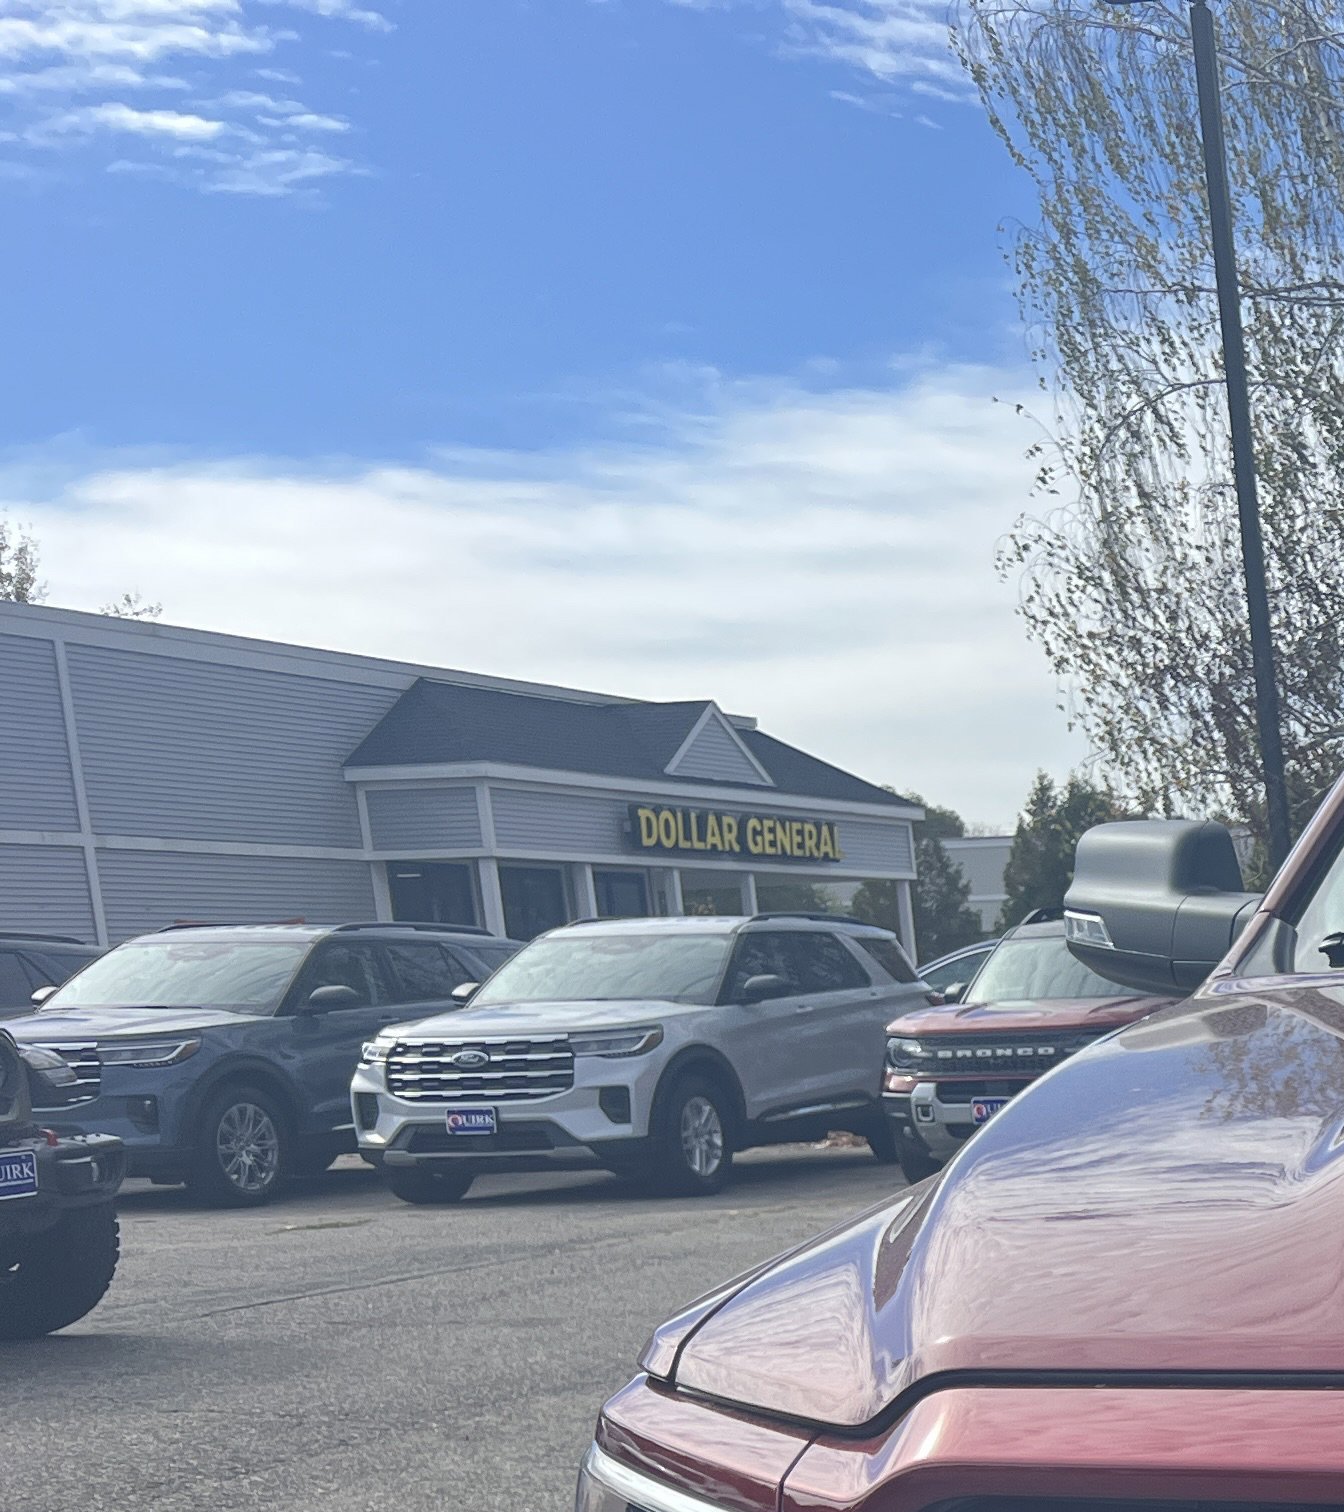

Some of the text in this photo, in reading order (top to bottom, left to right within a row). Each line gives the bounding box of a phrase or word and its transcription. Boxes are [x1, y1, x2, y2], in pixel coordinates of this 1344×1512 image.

[638, 808, 846, 860] DOLLAR GENERAL
[937, 1046, 1056, 1059] BRONCO
